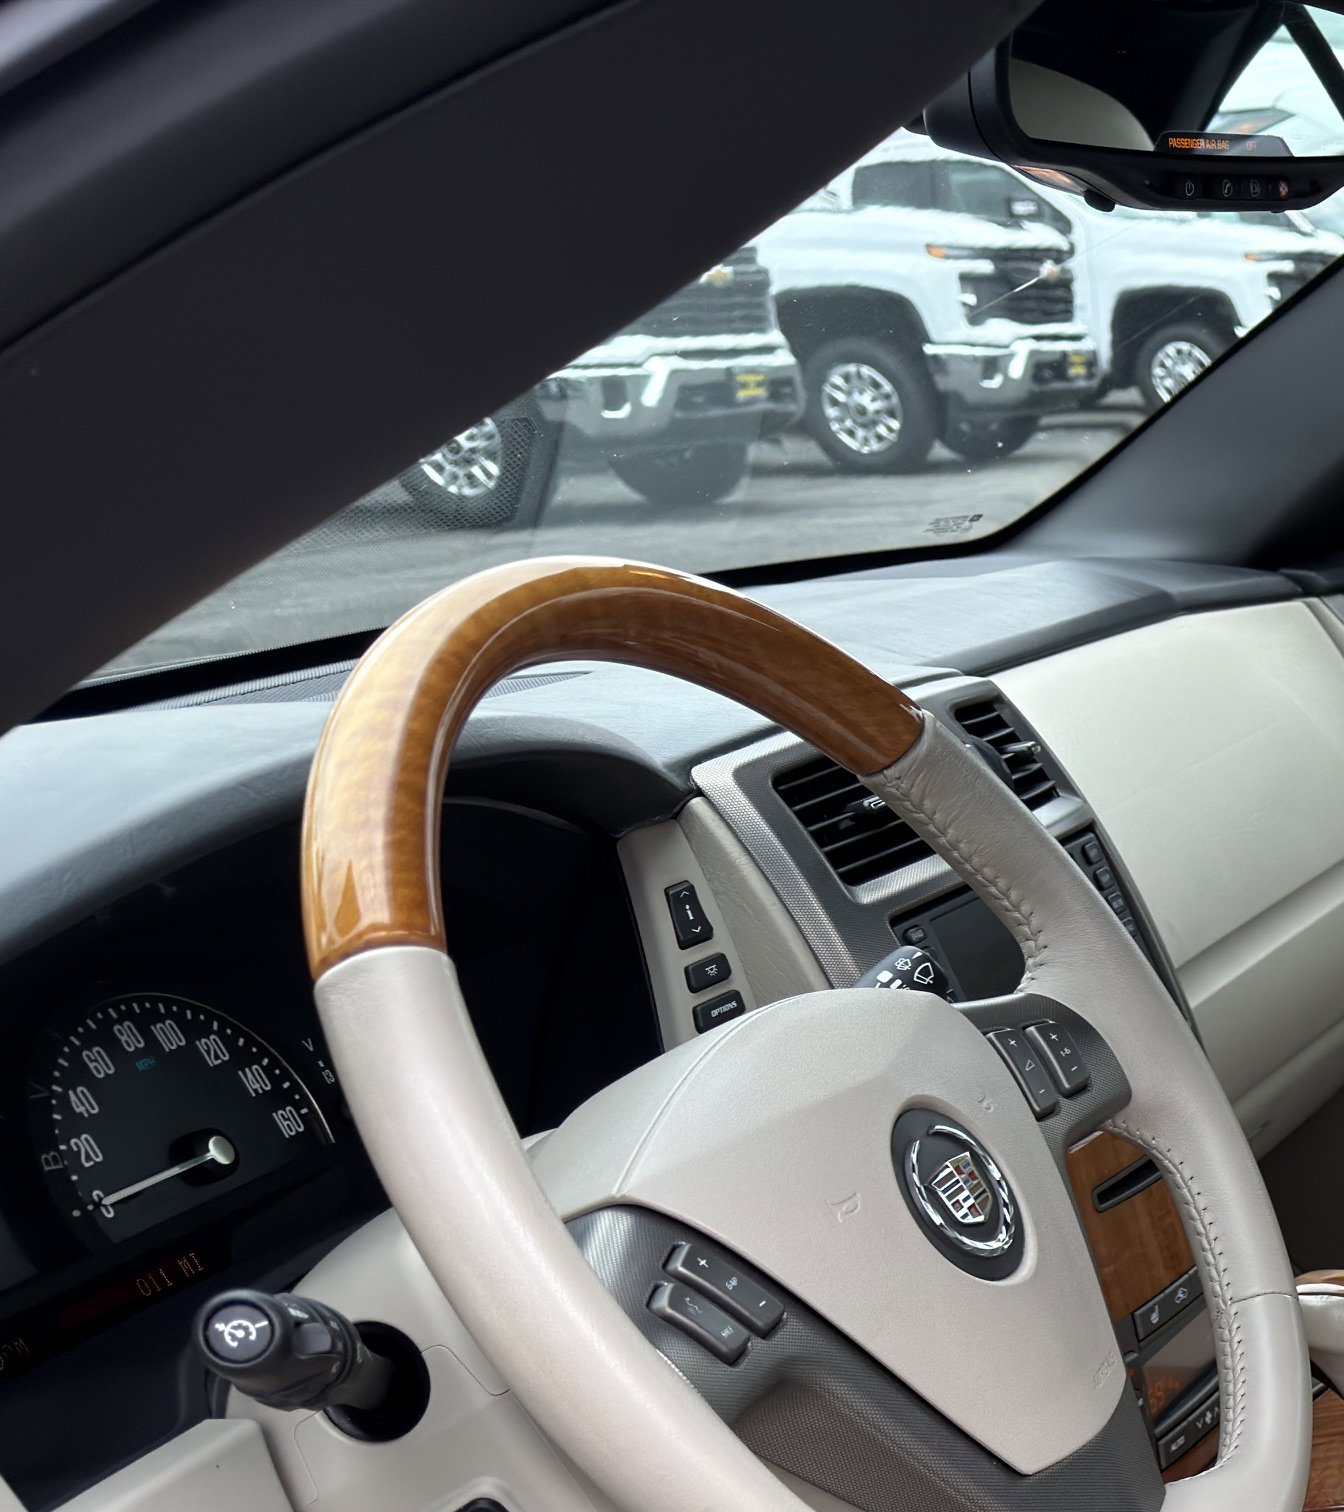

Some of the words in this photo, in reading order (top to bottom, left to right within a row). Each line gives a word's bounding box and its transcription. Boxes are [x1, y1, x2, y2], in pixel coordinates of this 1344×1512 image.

[1168, 137, 1205, 149] PASSENGER
[710, 1000, 738, 1018] OPTIONS
[113, 1020, 145, 1051] 80
[150, 1019, 186, 1052] 100
[196, 1034, 230, 1067] 120
[82, 1046, 115, 1078] 60
[238, 1063, 272, 1097] 140
[69, 1086, 99, 1117] 40
[272, 1104, 305, 1138] 160
[70, 1133, 103, 1168] 20
